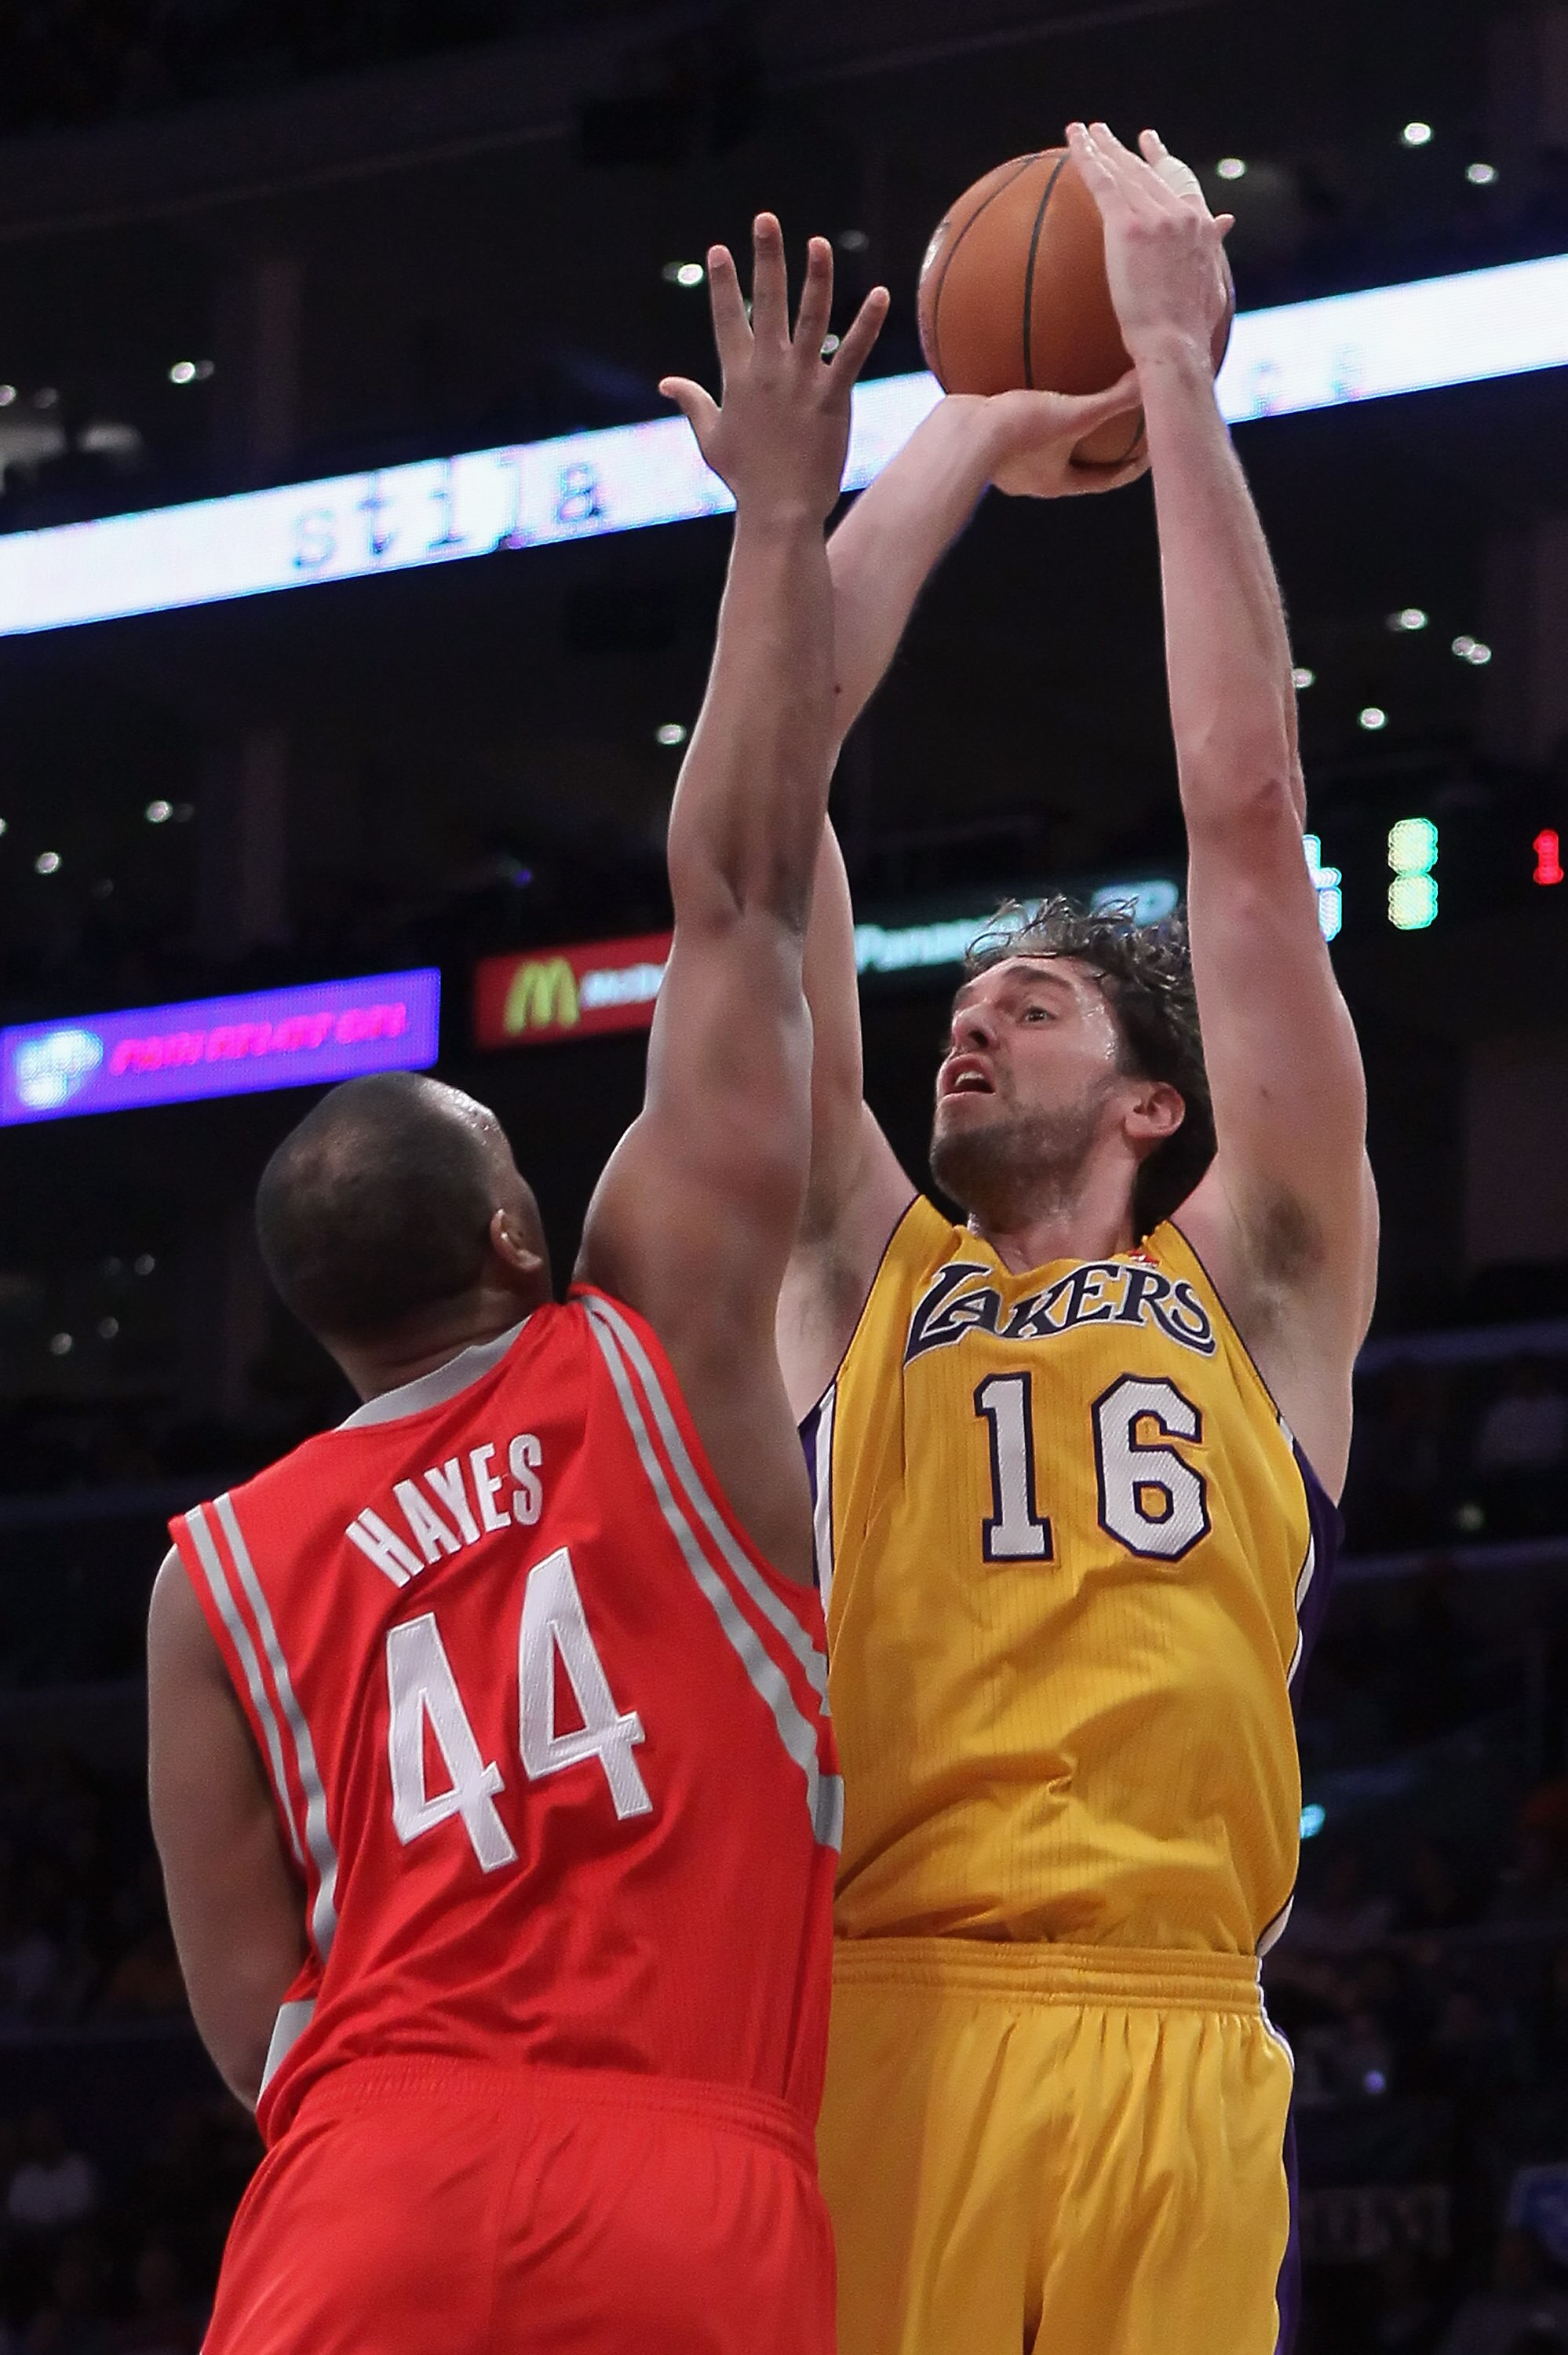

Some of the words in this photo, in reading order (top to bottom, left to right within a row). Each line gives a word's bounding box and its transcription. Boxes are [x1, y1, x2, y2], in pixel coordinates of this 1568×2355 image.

[903, 1261, 1216, 1369] LAKERS
[345, 1433, 542, 1588] HAYES
[974, 1371, 1211, 1562] 16
[387, 1546, 652, 1872] 44
